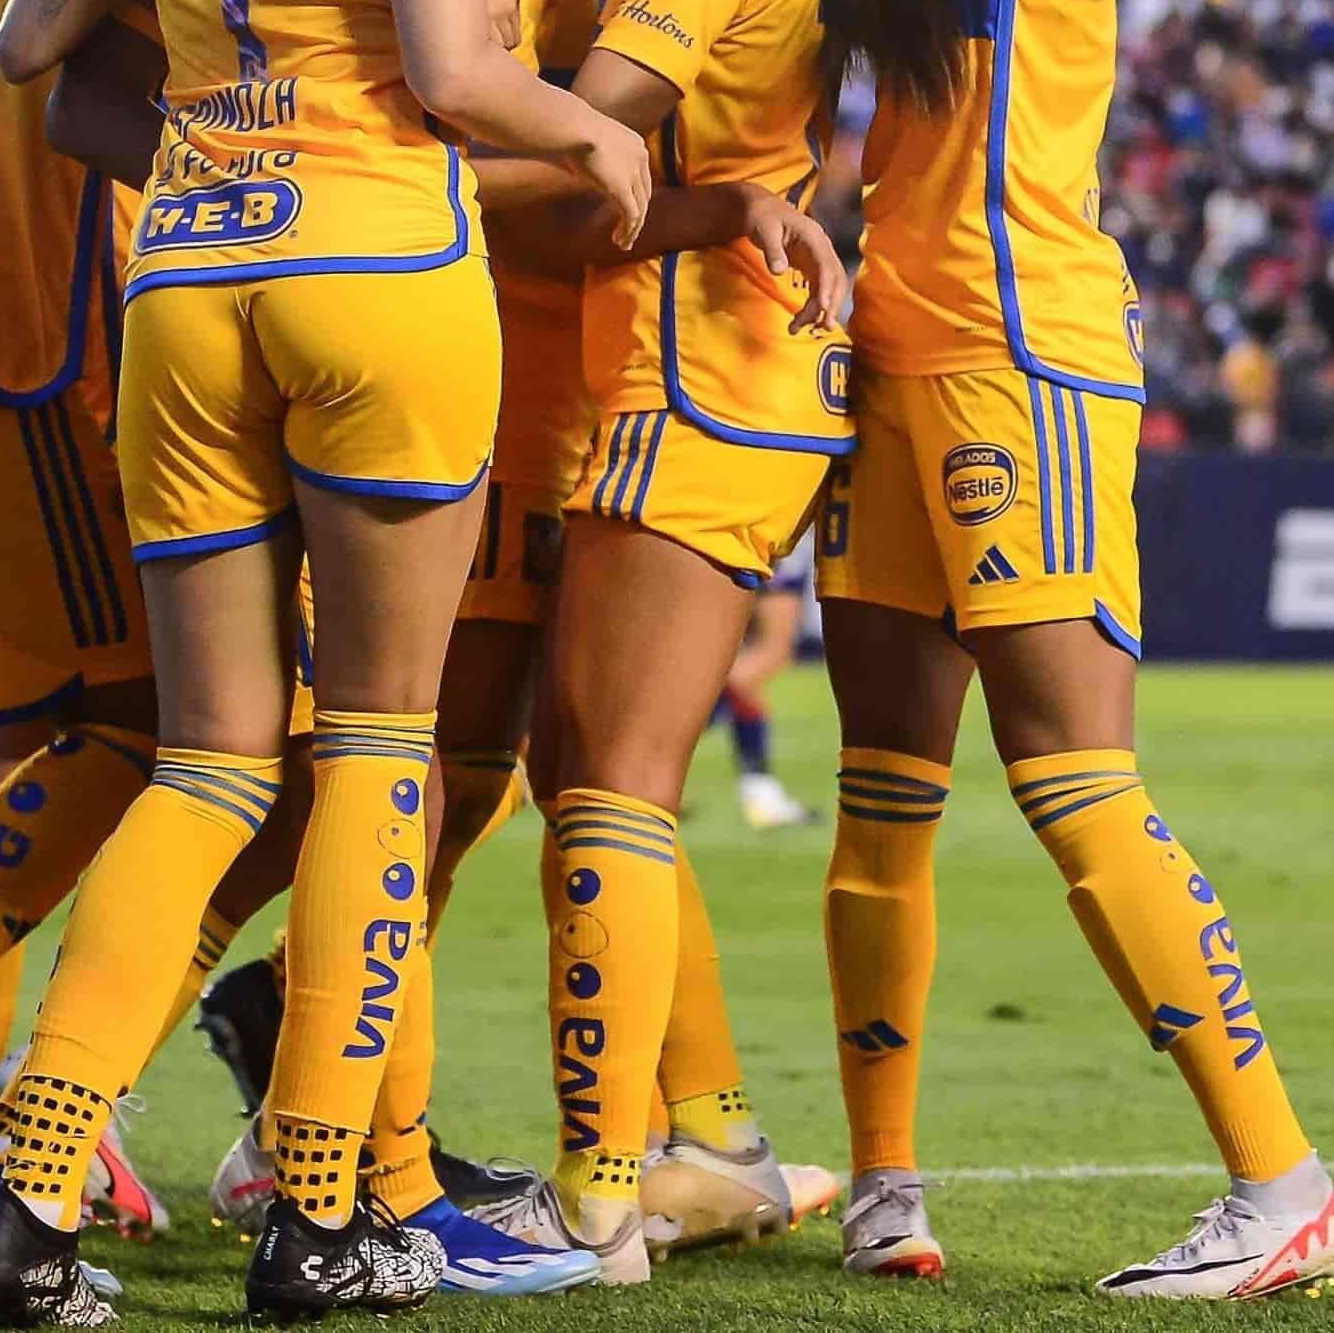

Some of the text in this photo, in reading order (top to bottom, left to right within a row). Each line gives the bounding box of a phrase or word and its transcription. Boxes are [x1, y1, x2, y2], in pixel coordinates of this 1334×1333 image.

[146, 192, 279, 240] H-E-B
[341, 918, 412, 1059] viva
[558, 1017, 606, 1153] viva
